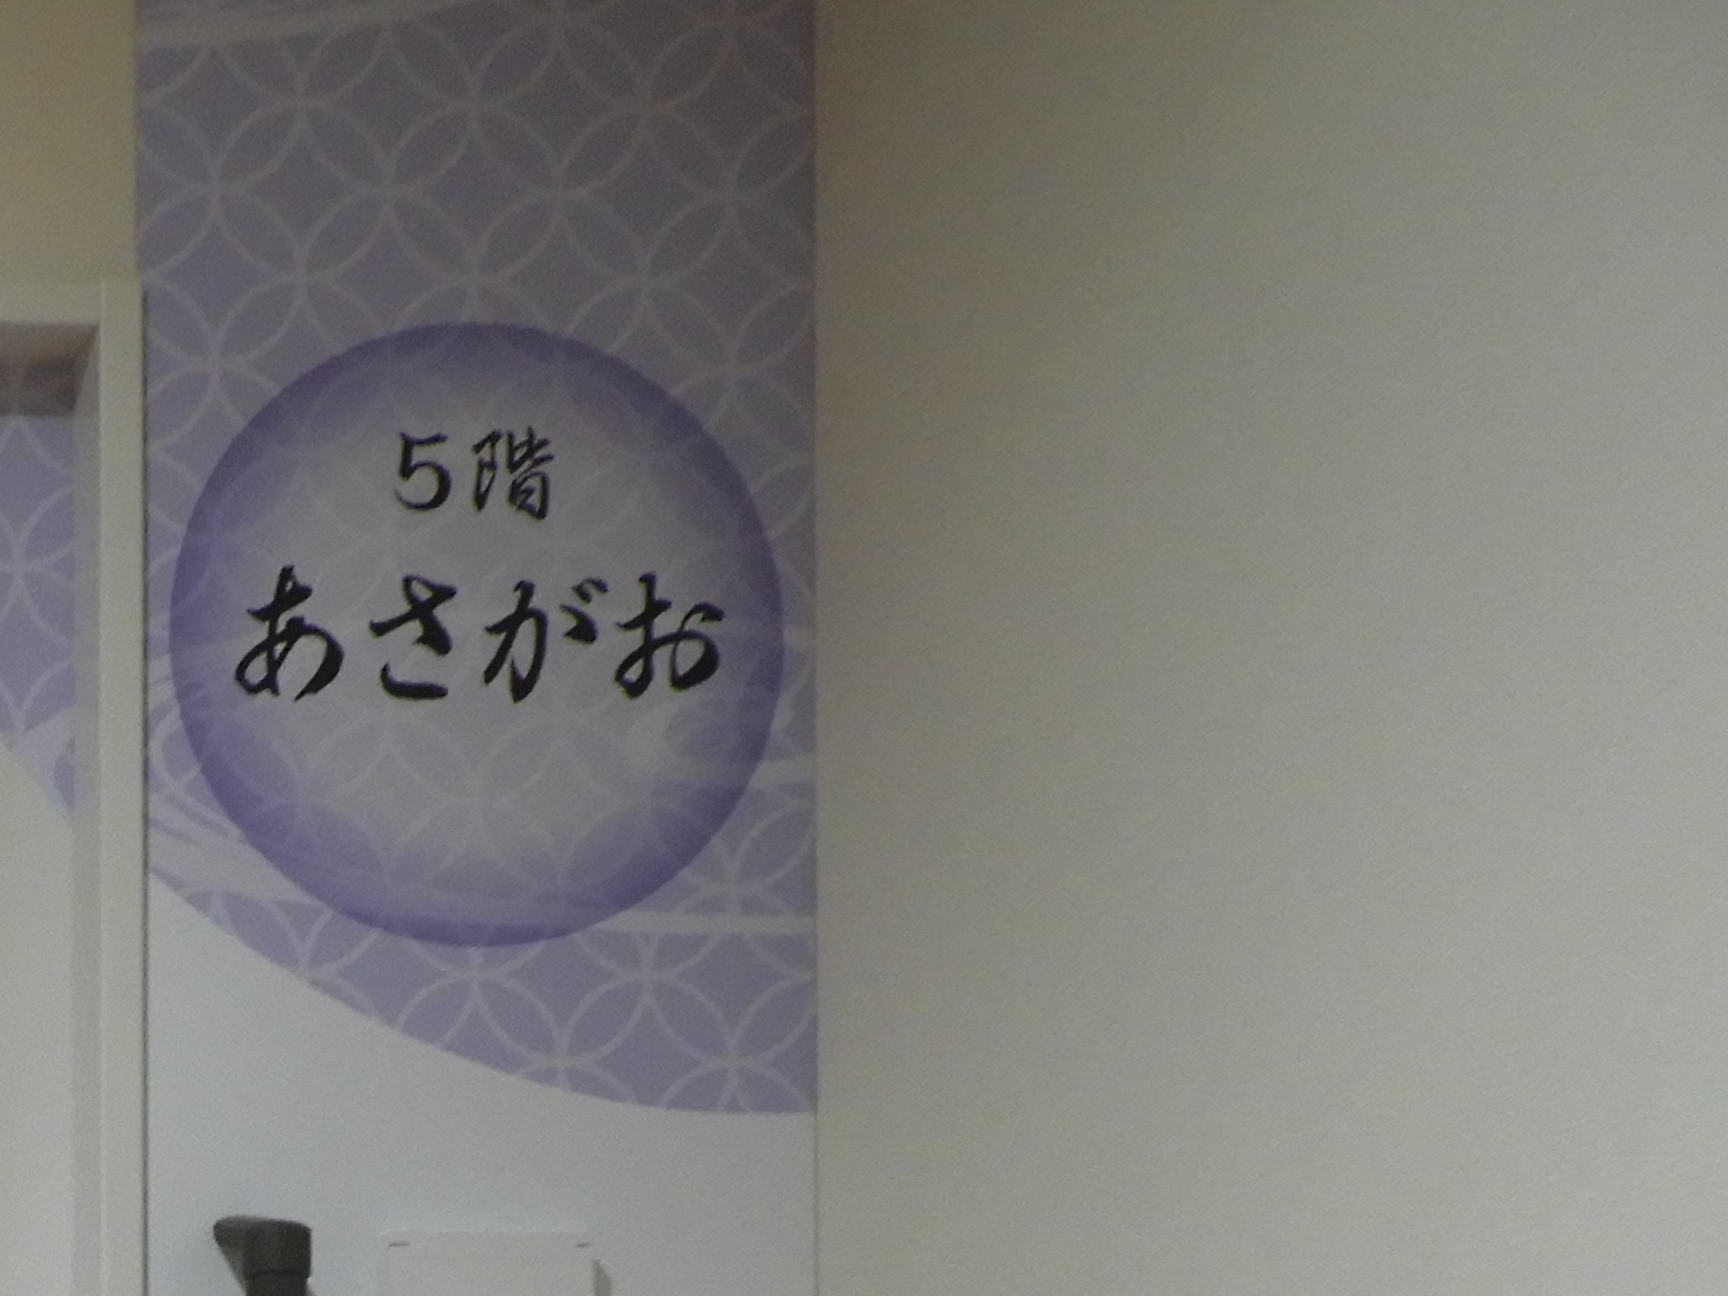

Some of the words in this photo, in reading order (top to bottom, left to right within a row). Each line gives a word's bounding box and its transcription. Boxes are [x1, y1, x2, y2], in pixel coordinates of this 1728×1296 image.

[394, 427, 554, 520] 5階
[234, 565, 725, 703] あさがお
